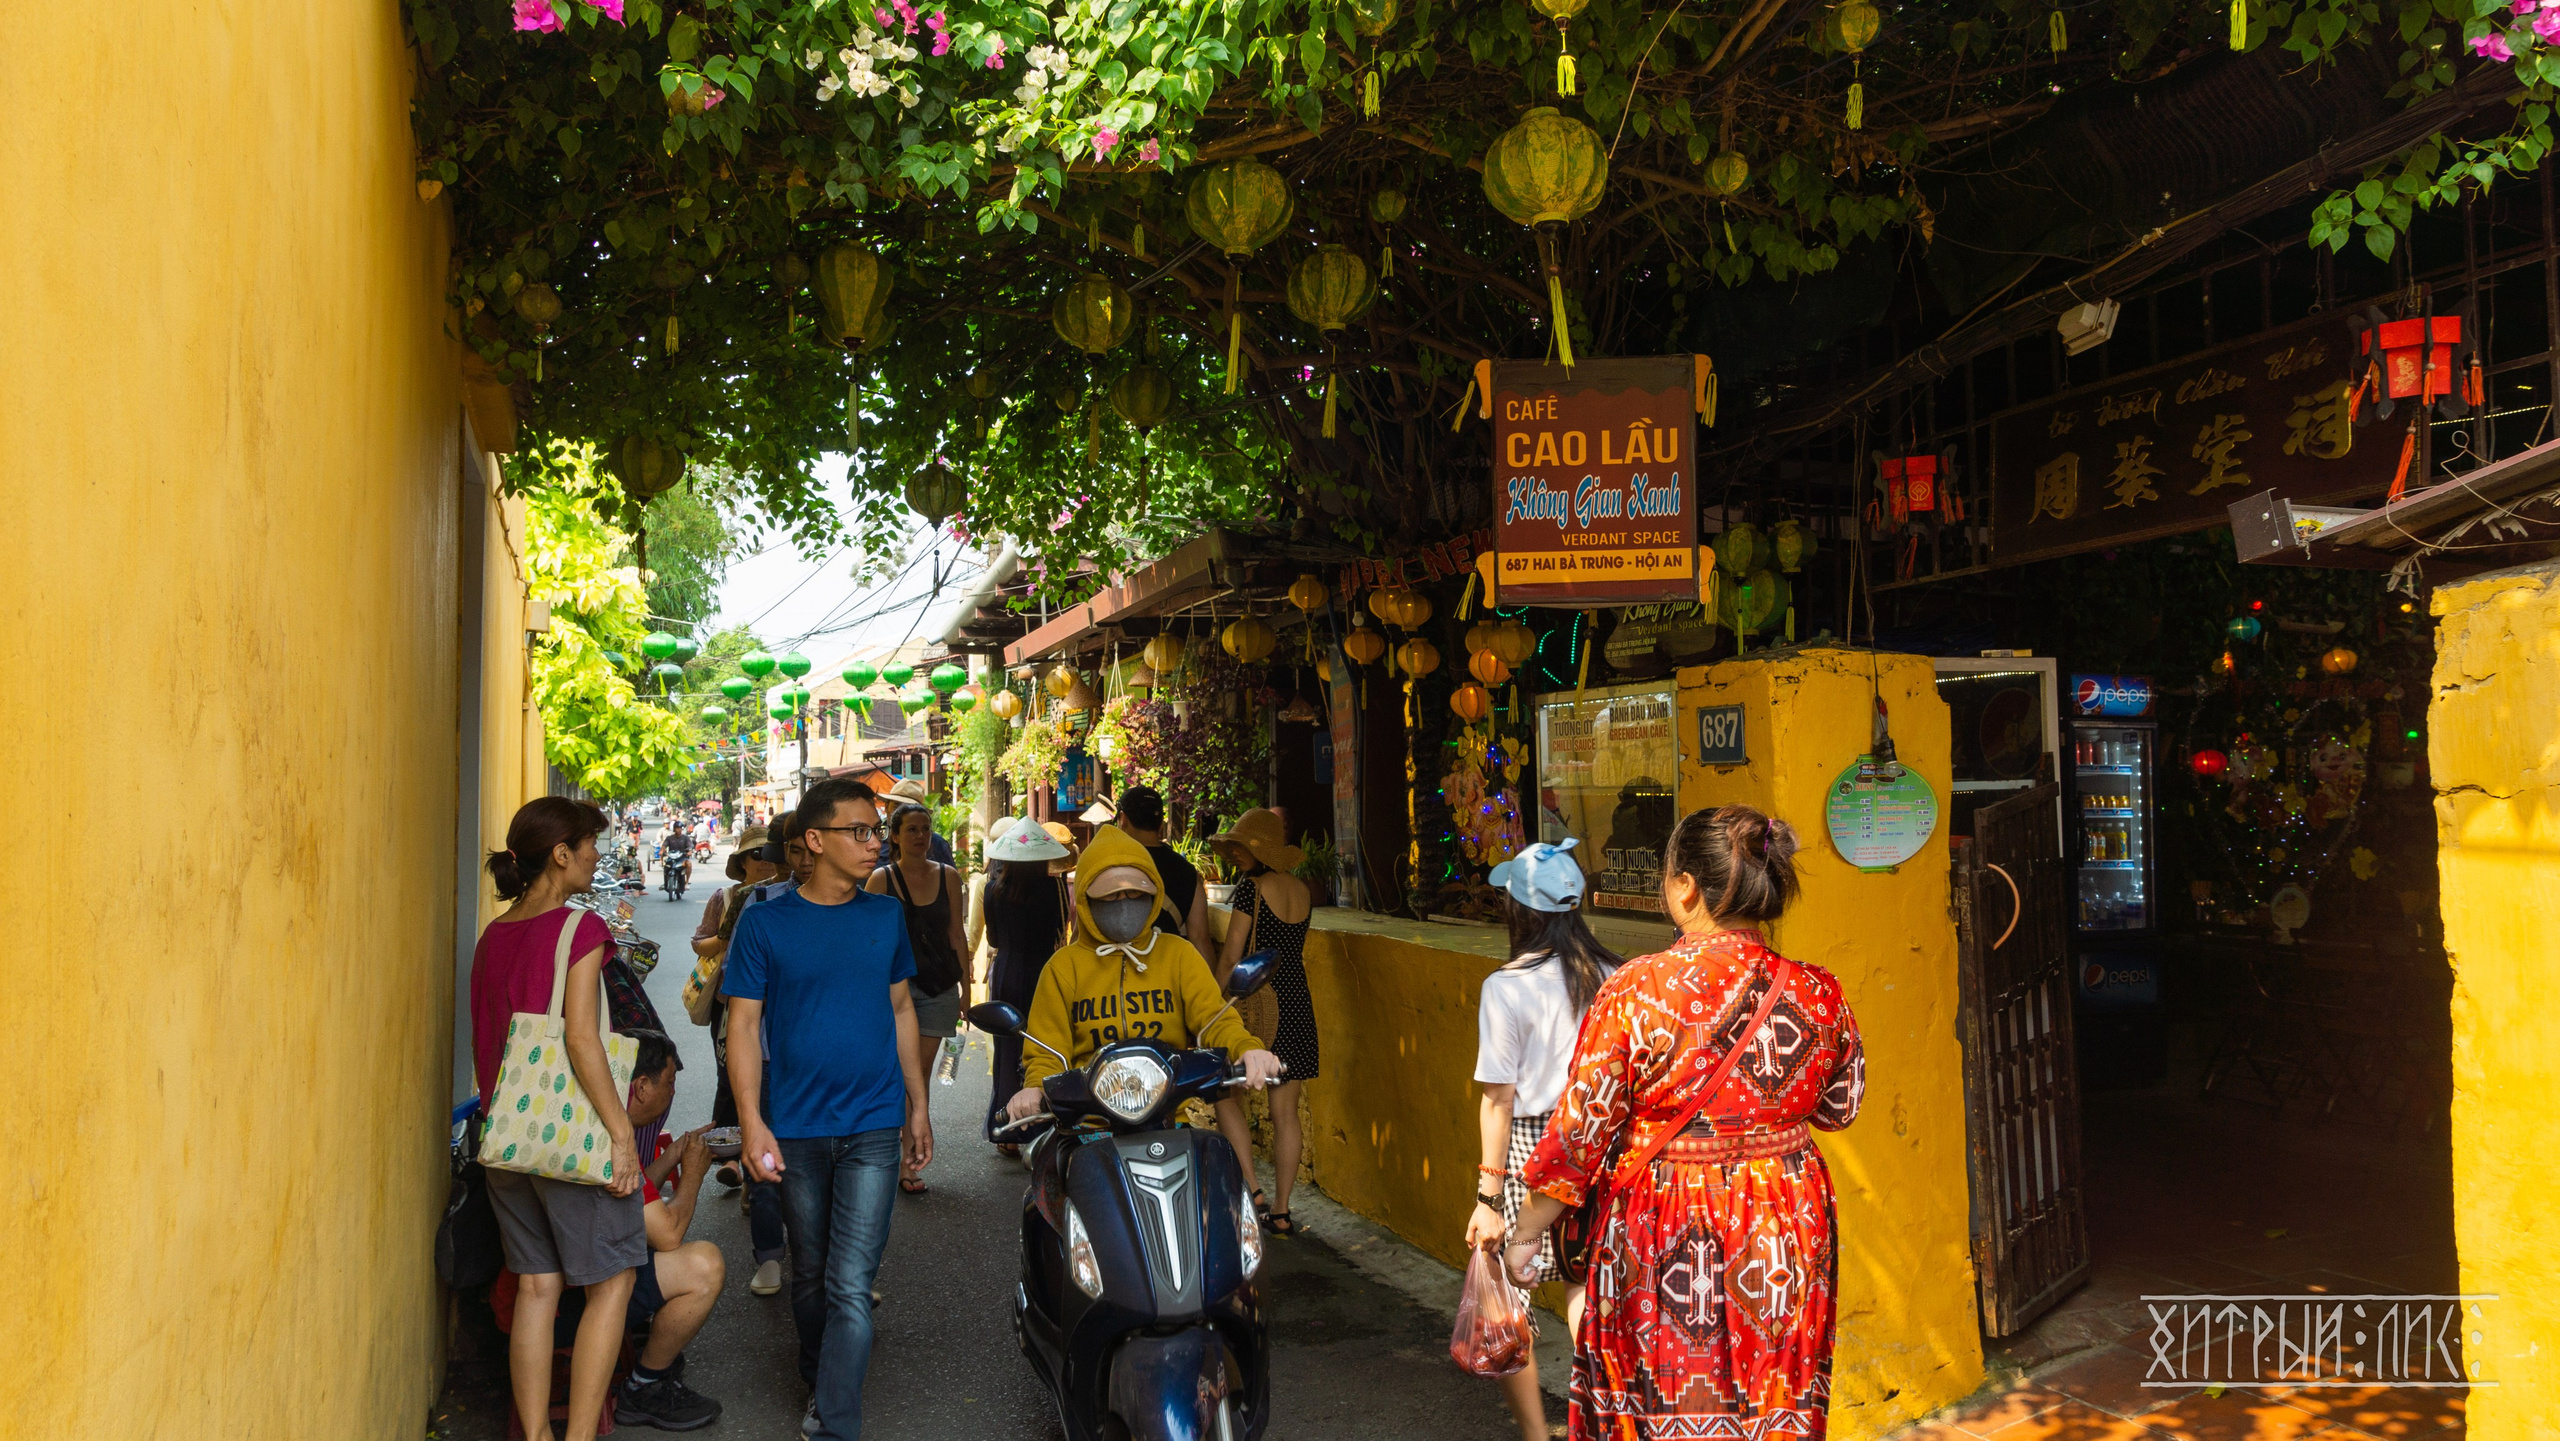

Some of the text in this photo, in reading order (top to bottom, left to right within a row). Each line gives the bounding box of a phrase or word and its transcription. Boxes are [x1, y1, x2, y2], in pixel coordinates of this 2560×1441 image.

[1506, 418, 1679, 468] CAO LẦU
[1506, 472, 1681, 529] Không Gian Xanh
[1562, 531, 1680, 546] VERDANT SPACE
[1421, 528, 1495, 583] NEW
[1506, 558, 1529, 571] 687
[1533, 557, 1556, 570] HAI
[1560, 554, 1577, 570] BÀ
[1581, 555, 1624, 569] TRƯNG
[1636, 552, 1660, 571] HỘI
[1663, 555, 1682, 567] AN
[2104, 686, 2150, 706] pepsi
[1609, 704, 1629, 723] BÁNH
[1647, 701, 1668, 718] XANH
[1609, 724, 1668, 741] GREENBEAN CAKE
[1702, 712, 1738, 748] 687
[1552, 738, 1596, 752] CHILLI SAUCE
[2109, 966, 2150, 986] pepsi
